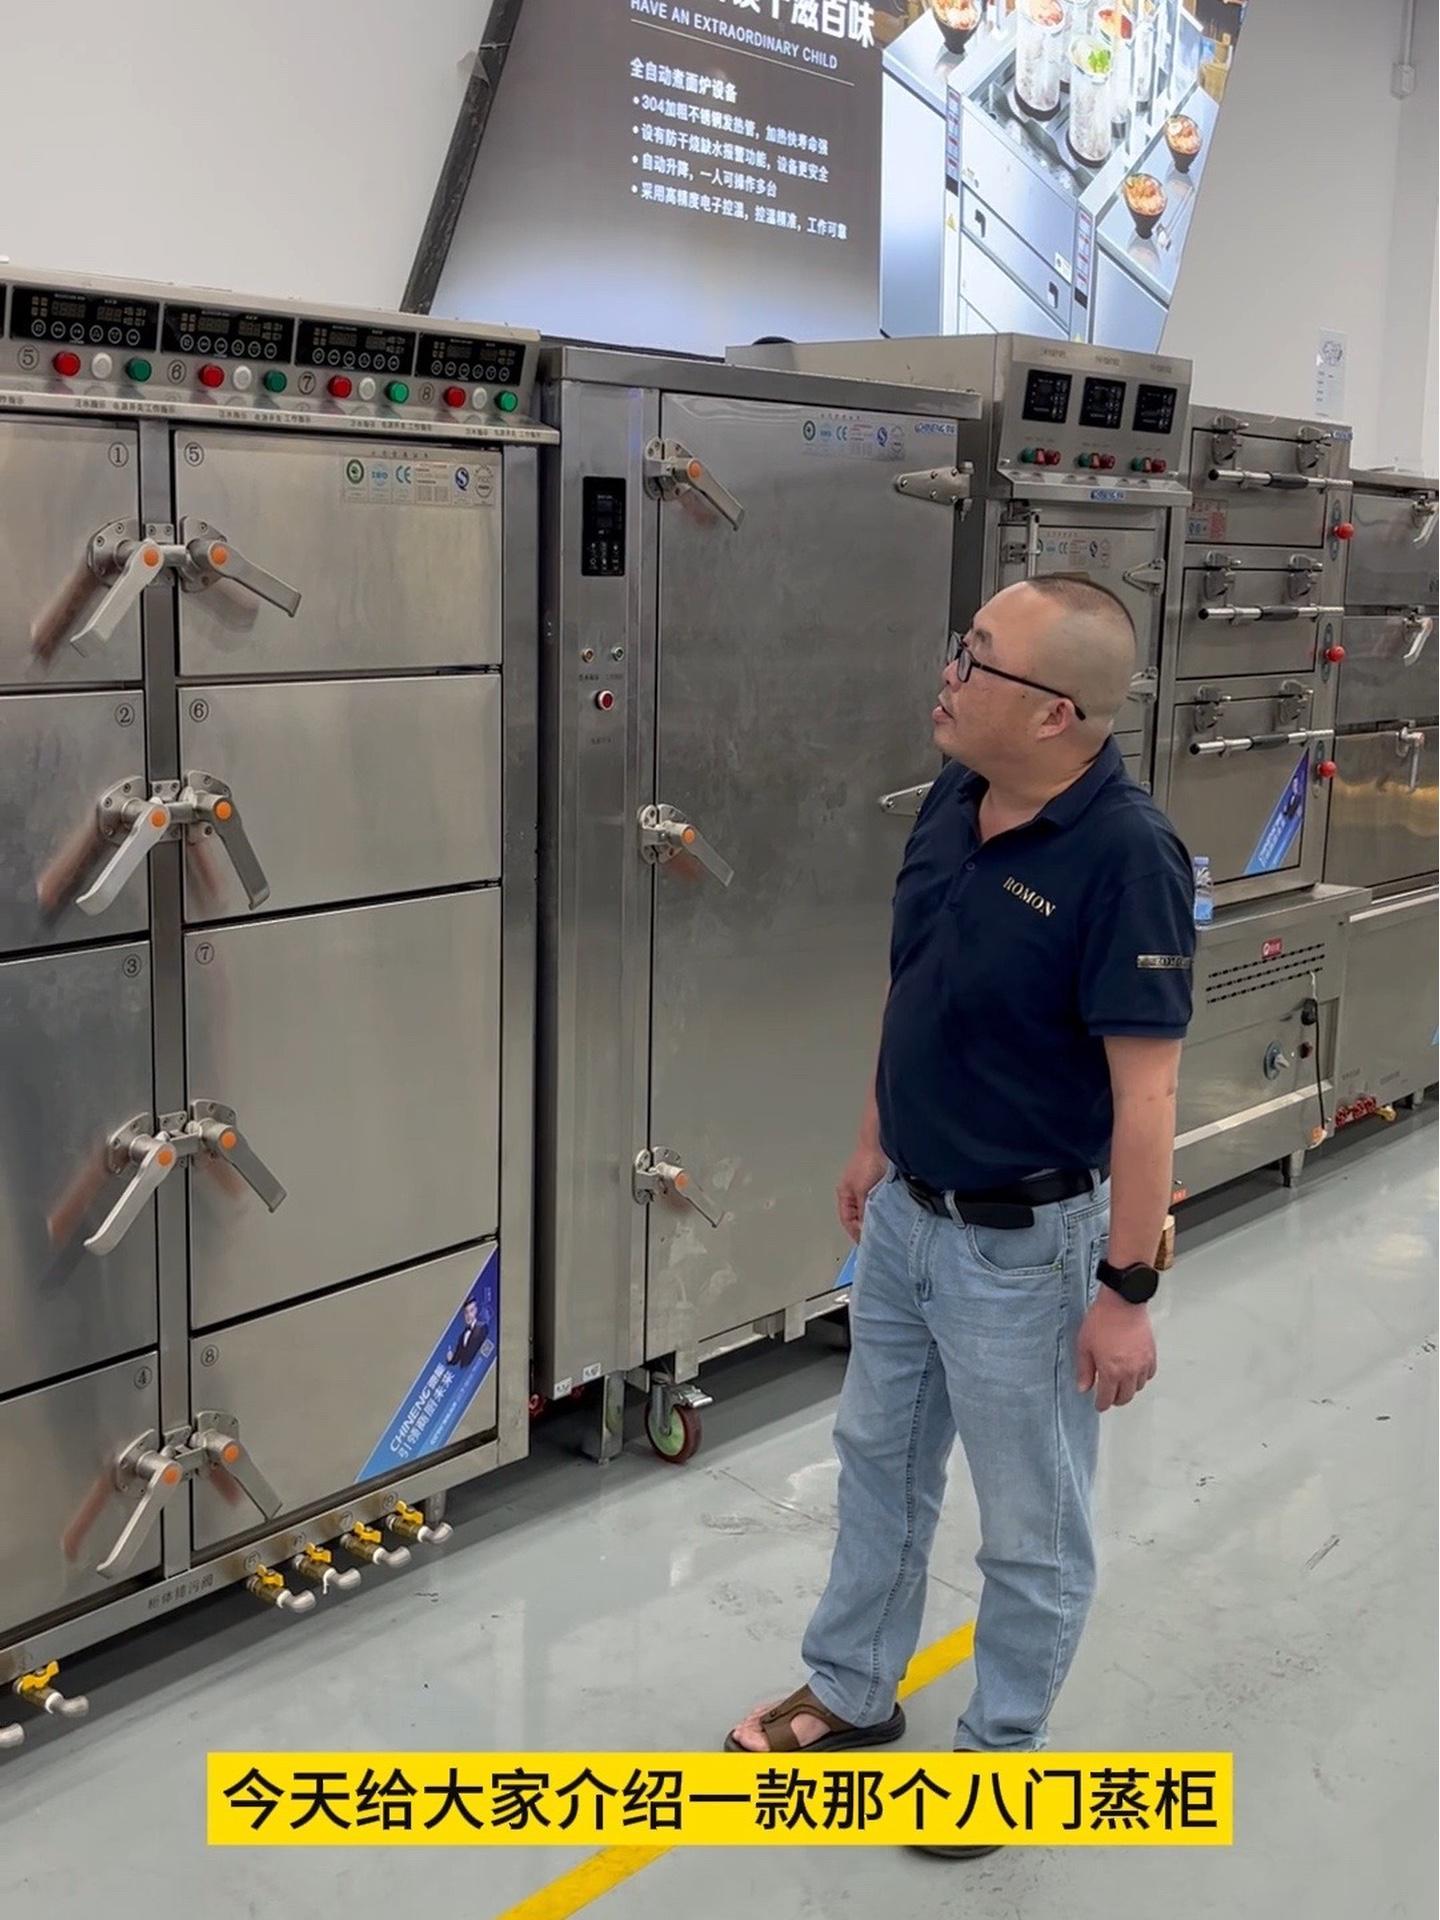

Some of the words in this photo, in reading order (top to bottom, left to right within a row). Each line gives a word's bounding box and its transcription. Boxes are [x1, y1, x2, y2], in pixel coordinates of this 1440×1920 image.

[630, 0, 668, 18] HAVE
[672, 6, 690, 26] AN
[694, 14, 800, 58] EXTRAORDINARY
[802, 46, 838, 70] CHILD
[630, 57, 738, 104] 全自动煮面炉设备
[1003, 876, 1056, 917] ROMON
